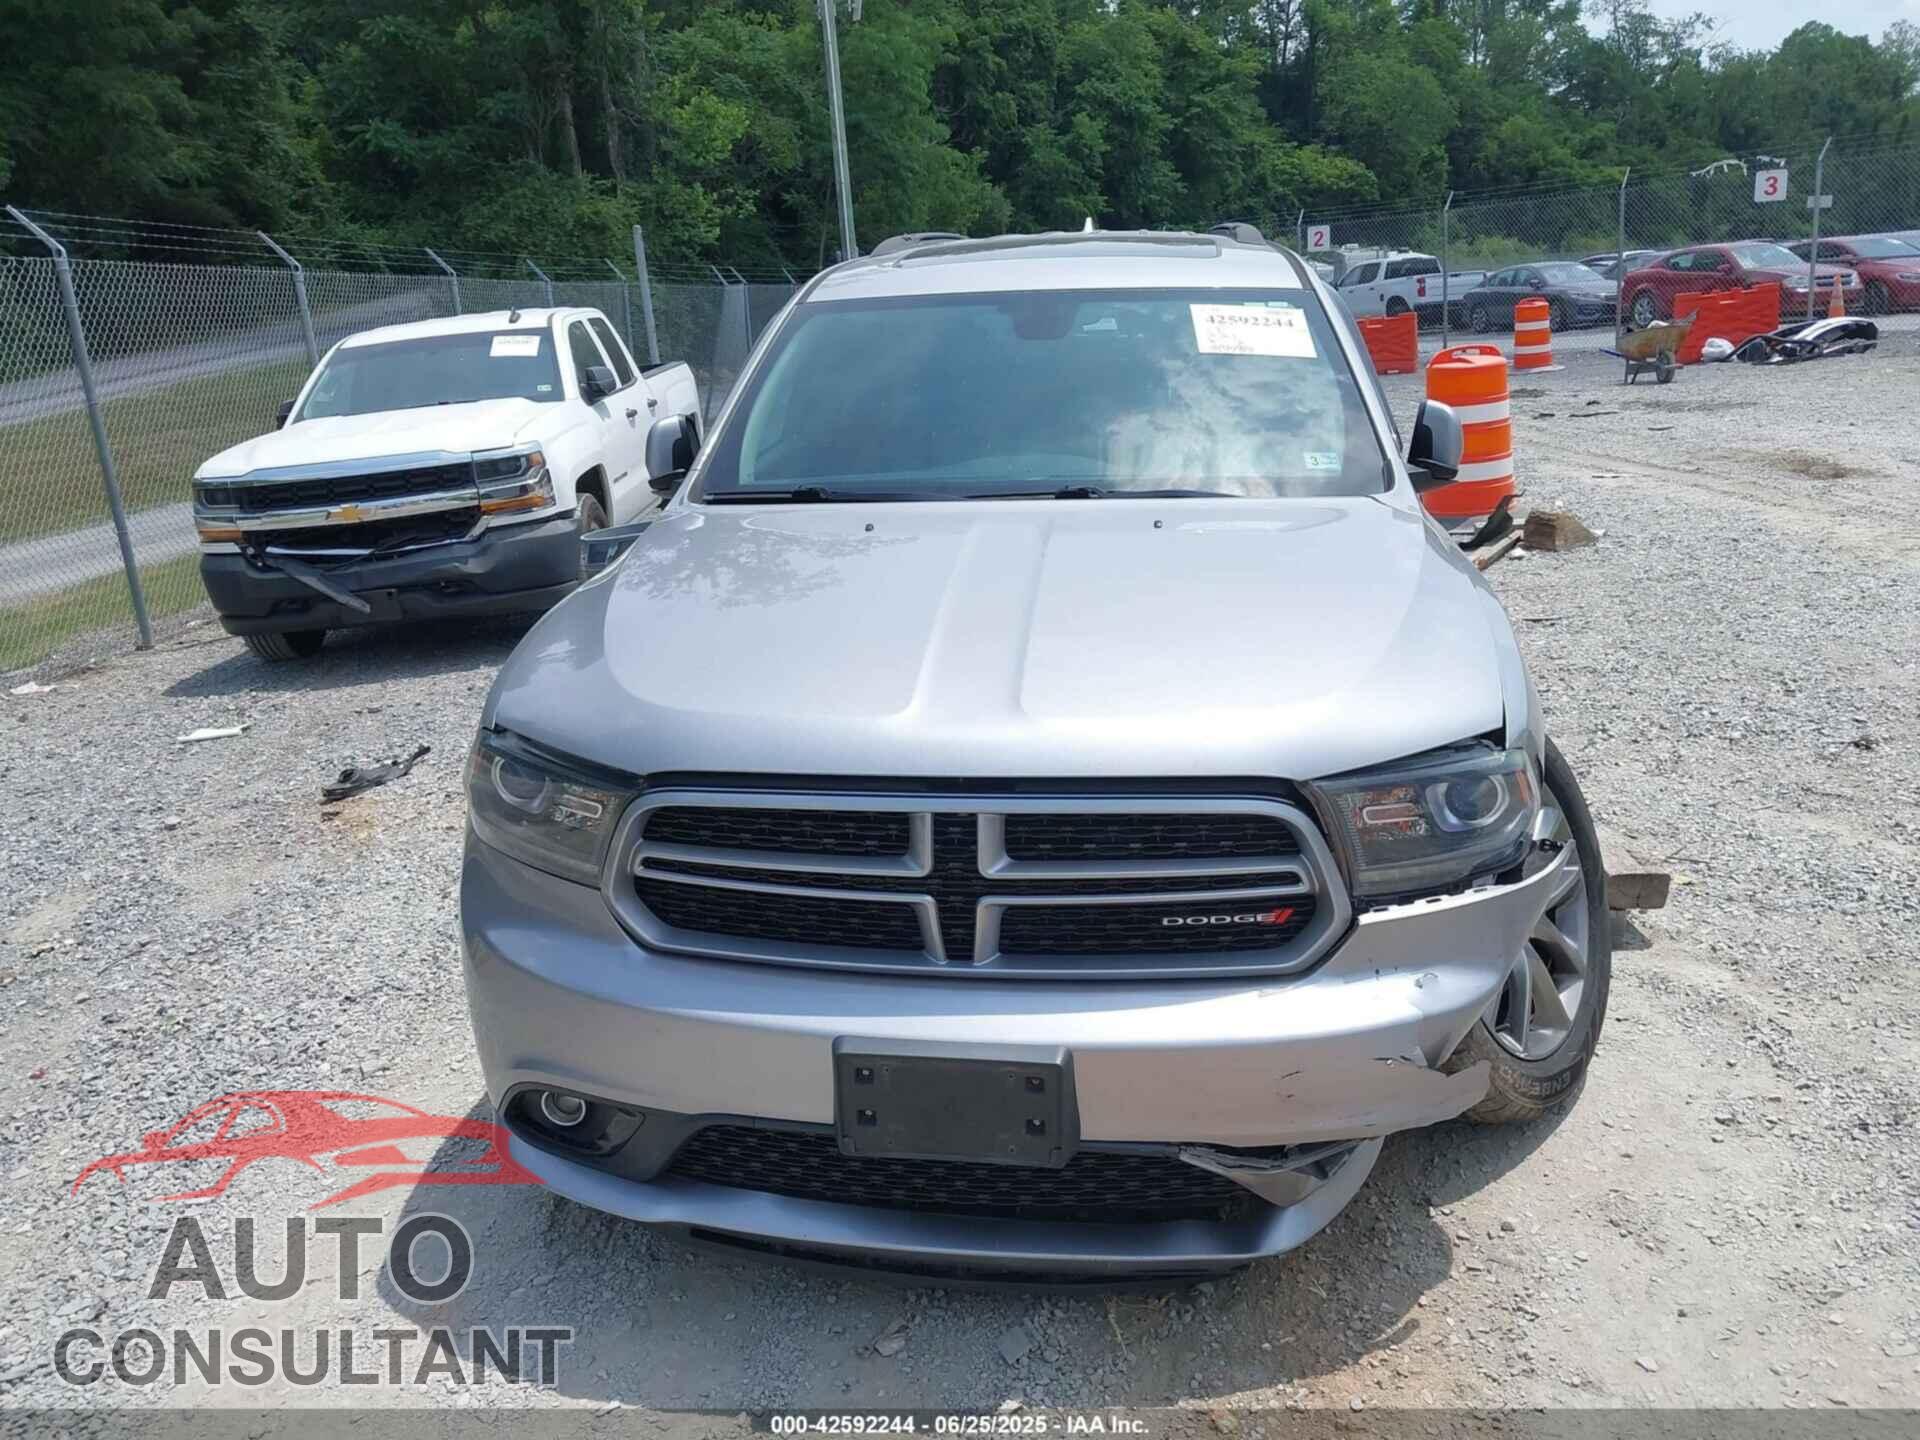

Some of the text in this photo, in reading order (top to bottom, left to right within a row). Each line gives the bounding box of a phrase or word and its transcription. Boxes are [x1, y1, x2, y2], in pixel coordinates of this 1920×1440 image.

[1763, 176, 1778, 196] 3
[1314, 230, 1325, 247] 2
[1162, 912, 1277, 926] DODGE
